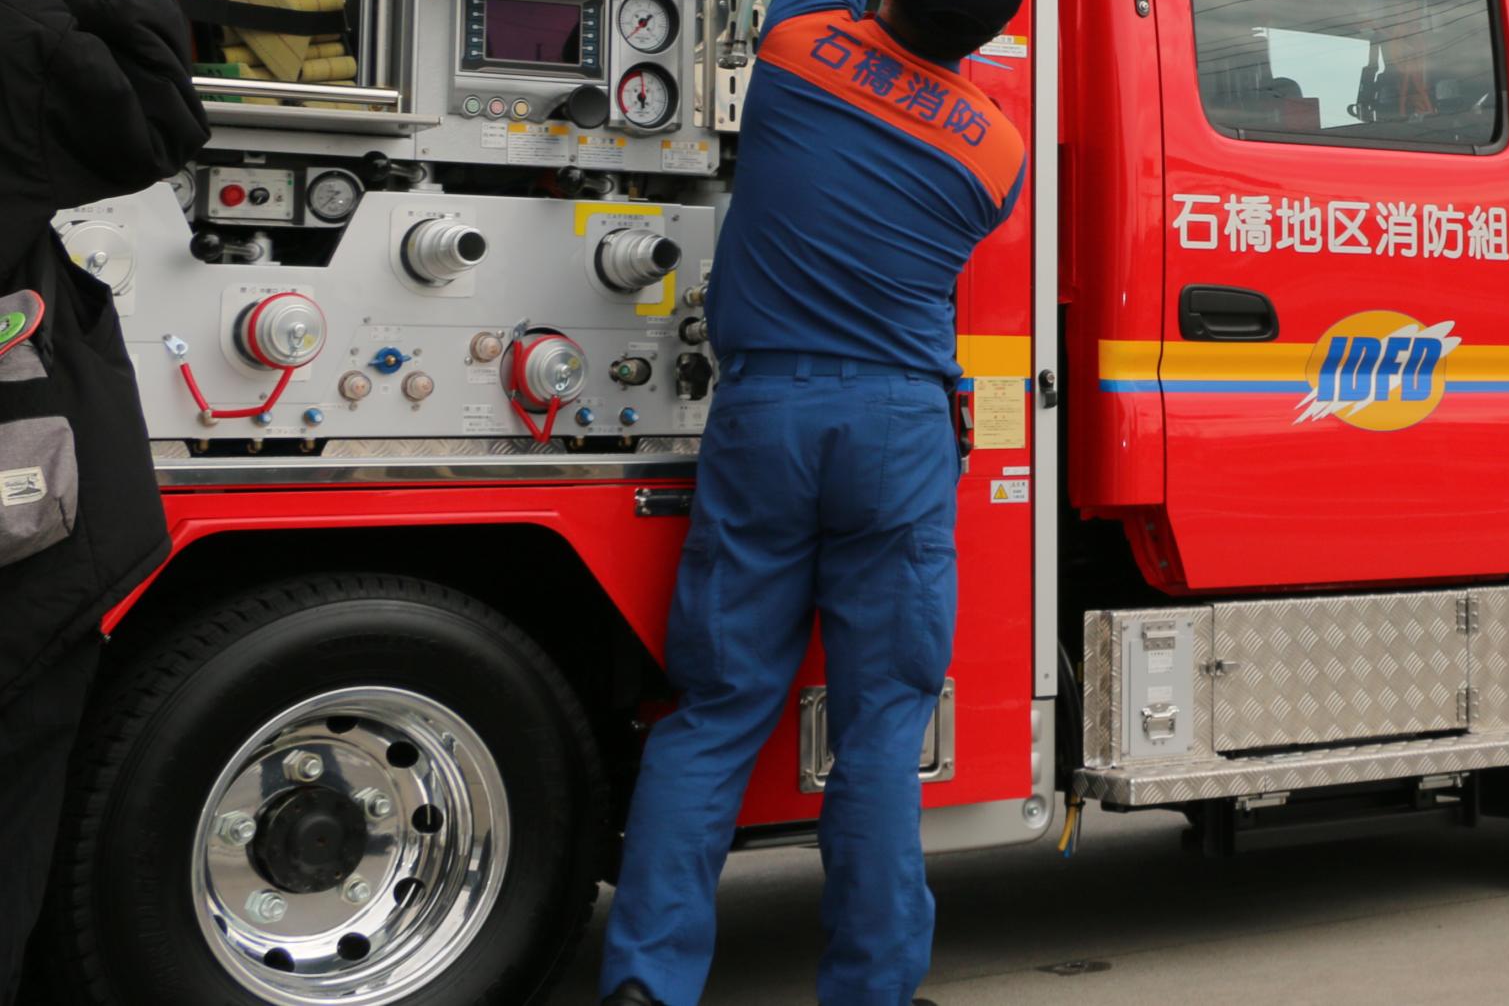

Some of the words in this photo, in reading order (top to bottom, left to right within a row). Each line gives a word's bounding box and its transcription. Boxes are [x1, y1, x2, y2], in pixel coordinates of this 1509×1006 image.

[810, 24, 992, 147] 石橋消防
[1316, 336, 1443, 402] IDFD
